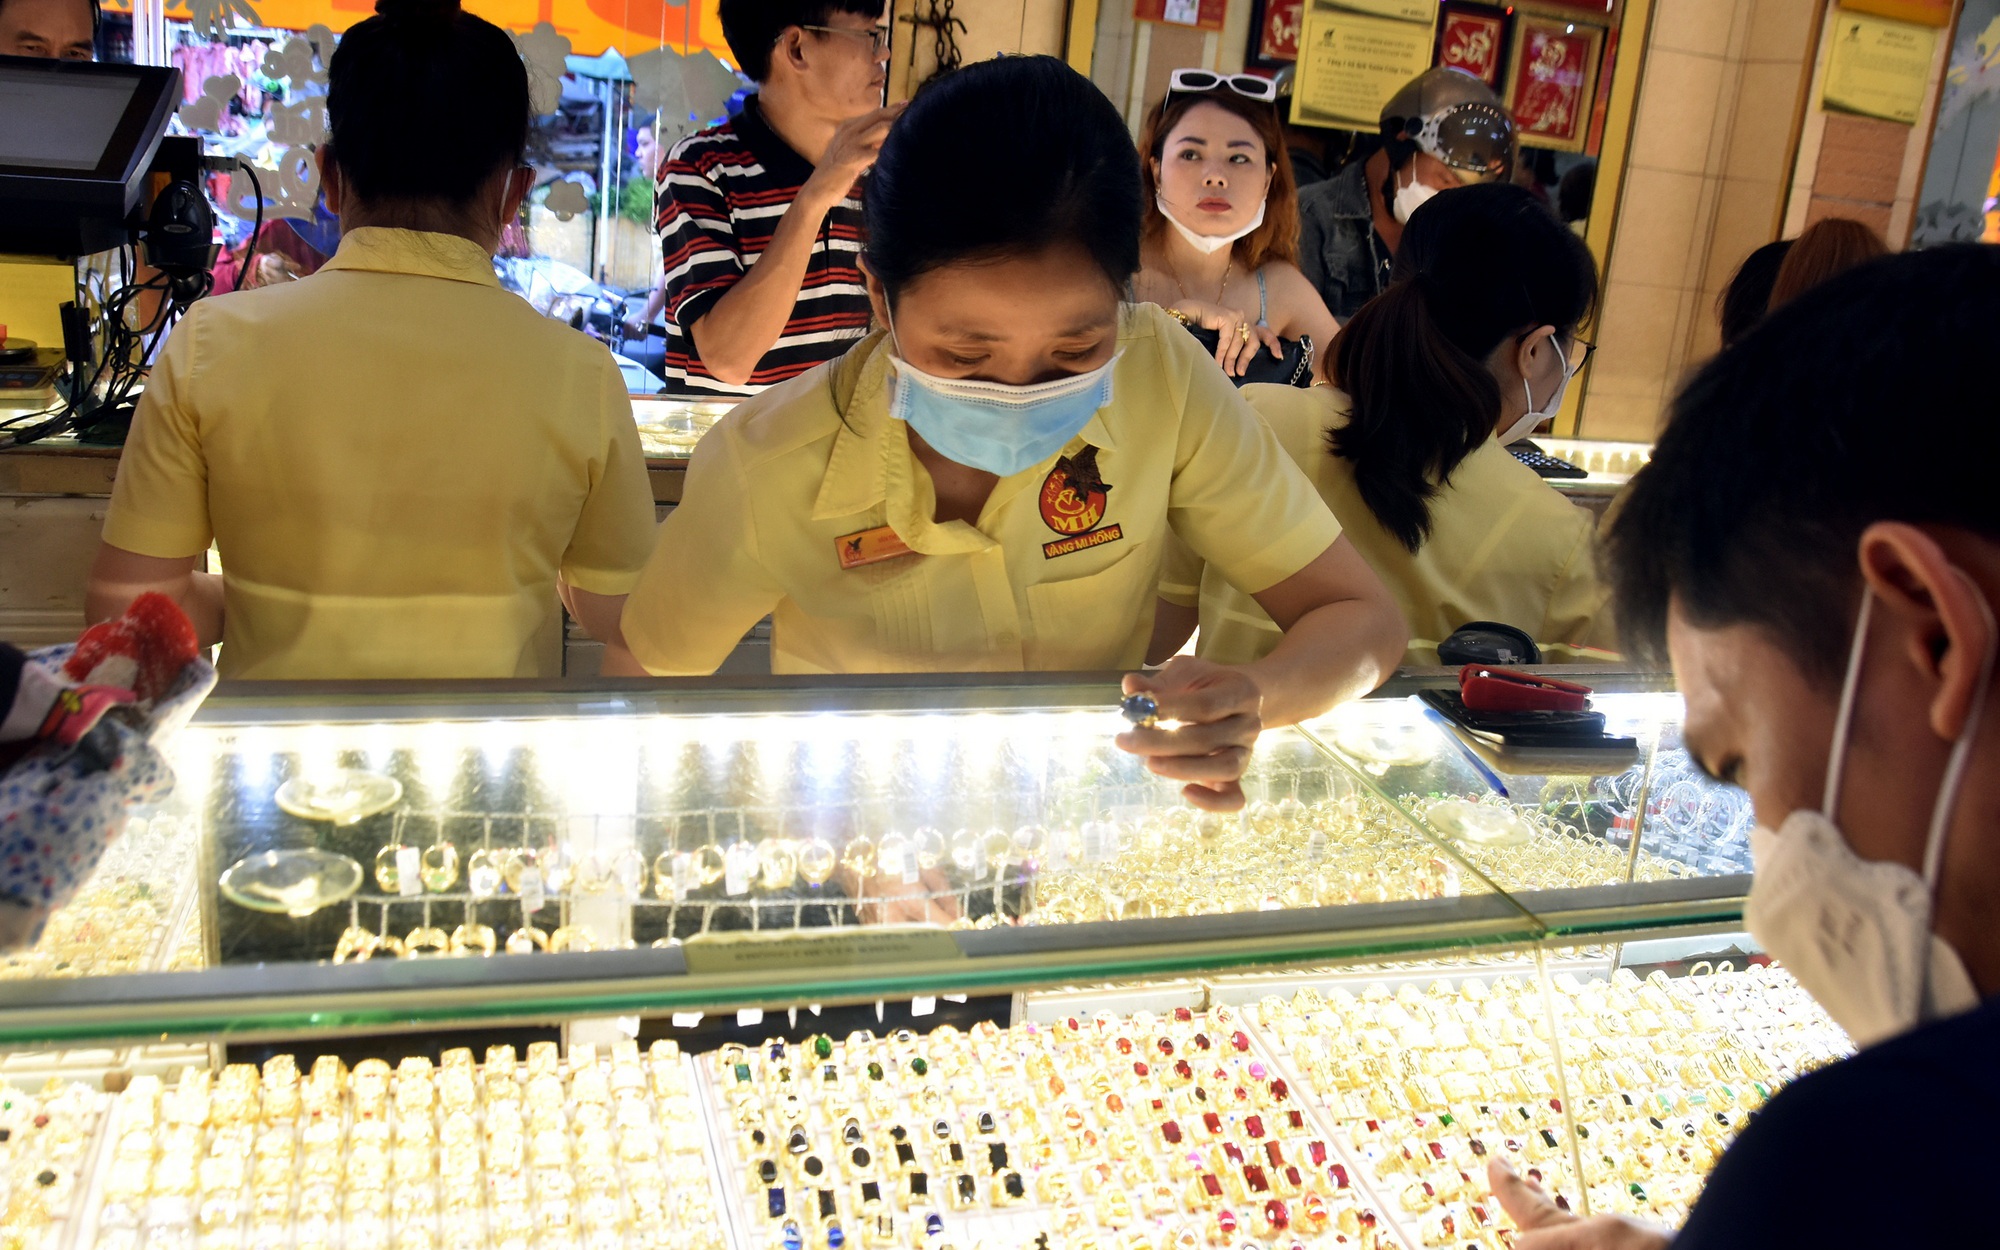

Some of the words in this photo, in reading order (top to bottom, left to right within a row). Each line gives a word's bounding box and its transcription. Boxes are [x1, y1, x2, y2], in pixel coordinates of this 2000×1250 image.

[1051, 503, 1100, 532] MH
[1045, 542, 1074, 557] VÀNG
[1075, 538, 1088, 549] MI
[1088, 529, 1120, 545] HỒNG
